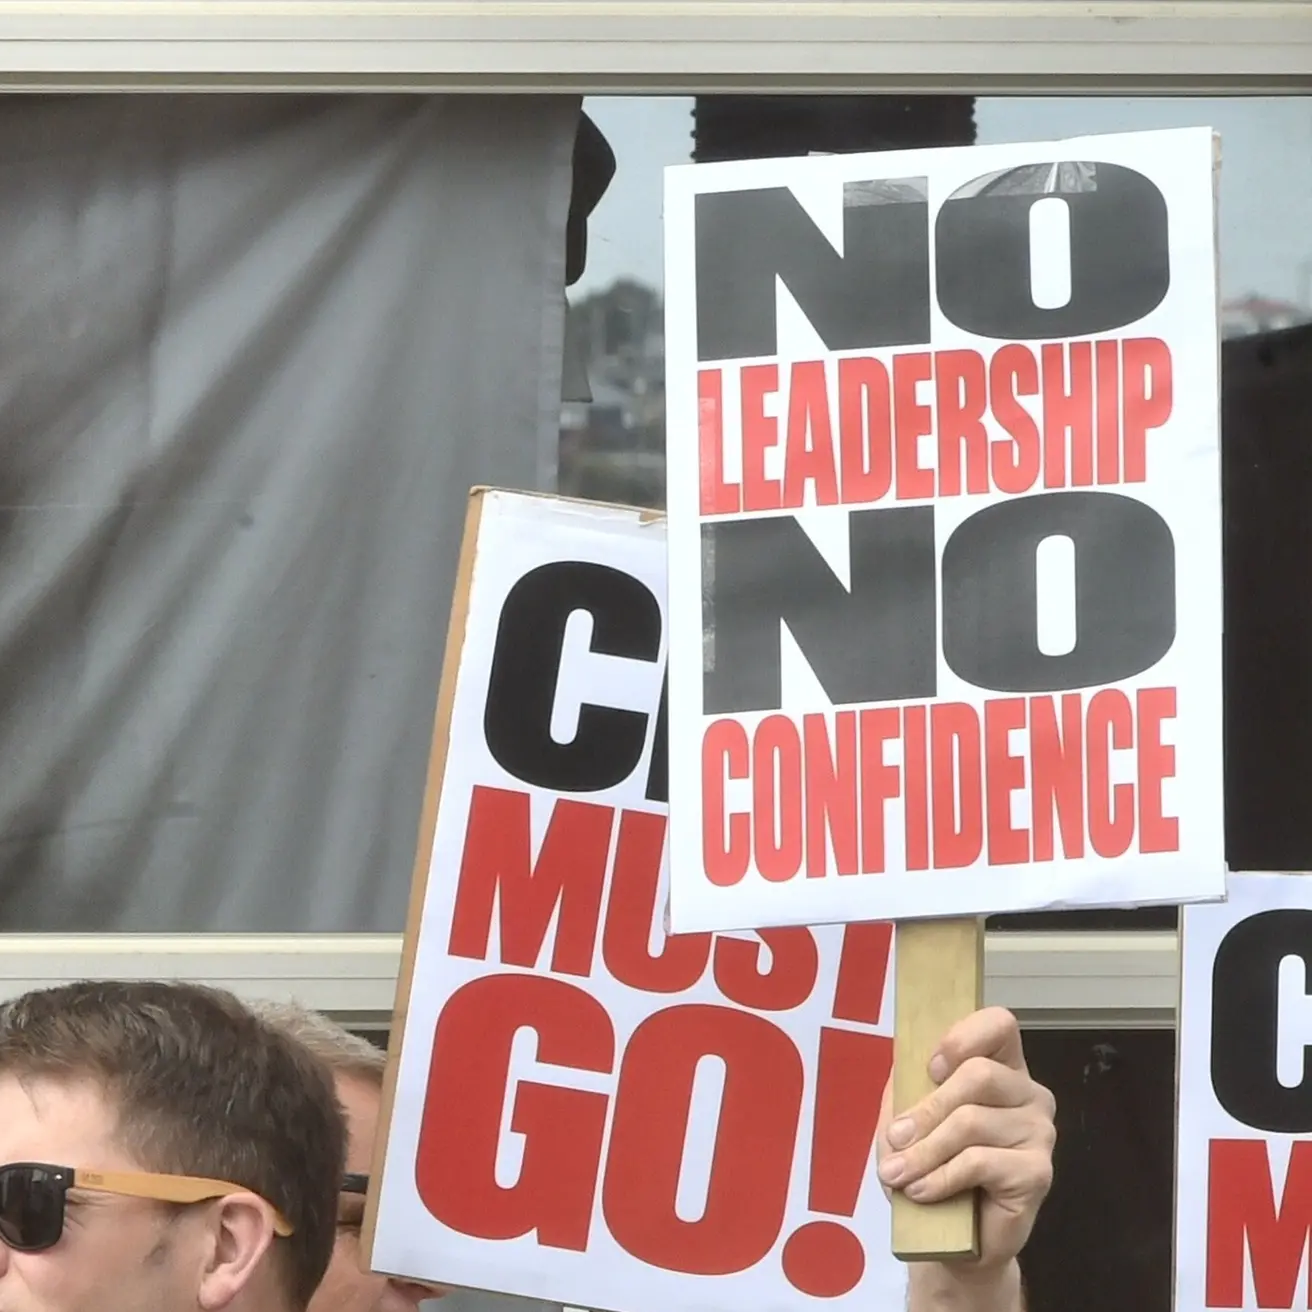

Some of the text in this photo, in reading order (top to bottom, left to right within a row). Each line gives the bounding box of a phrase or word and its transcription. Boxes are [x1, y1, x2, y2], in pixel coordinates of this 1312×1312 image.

[695, 161, 1171, 362] NO
[697, 336, 1174, 516] LEADERSHIP
[701, 492, 1177, 716] NO
[701, 686, 1180, 887] CONFIDENCE
[415, 972, 895, 1298] GO!
